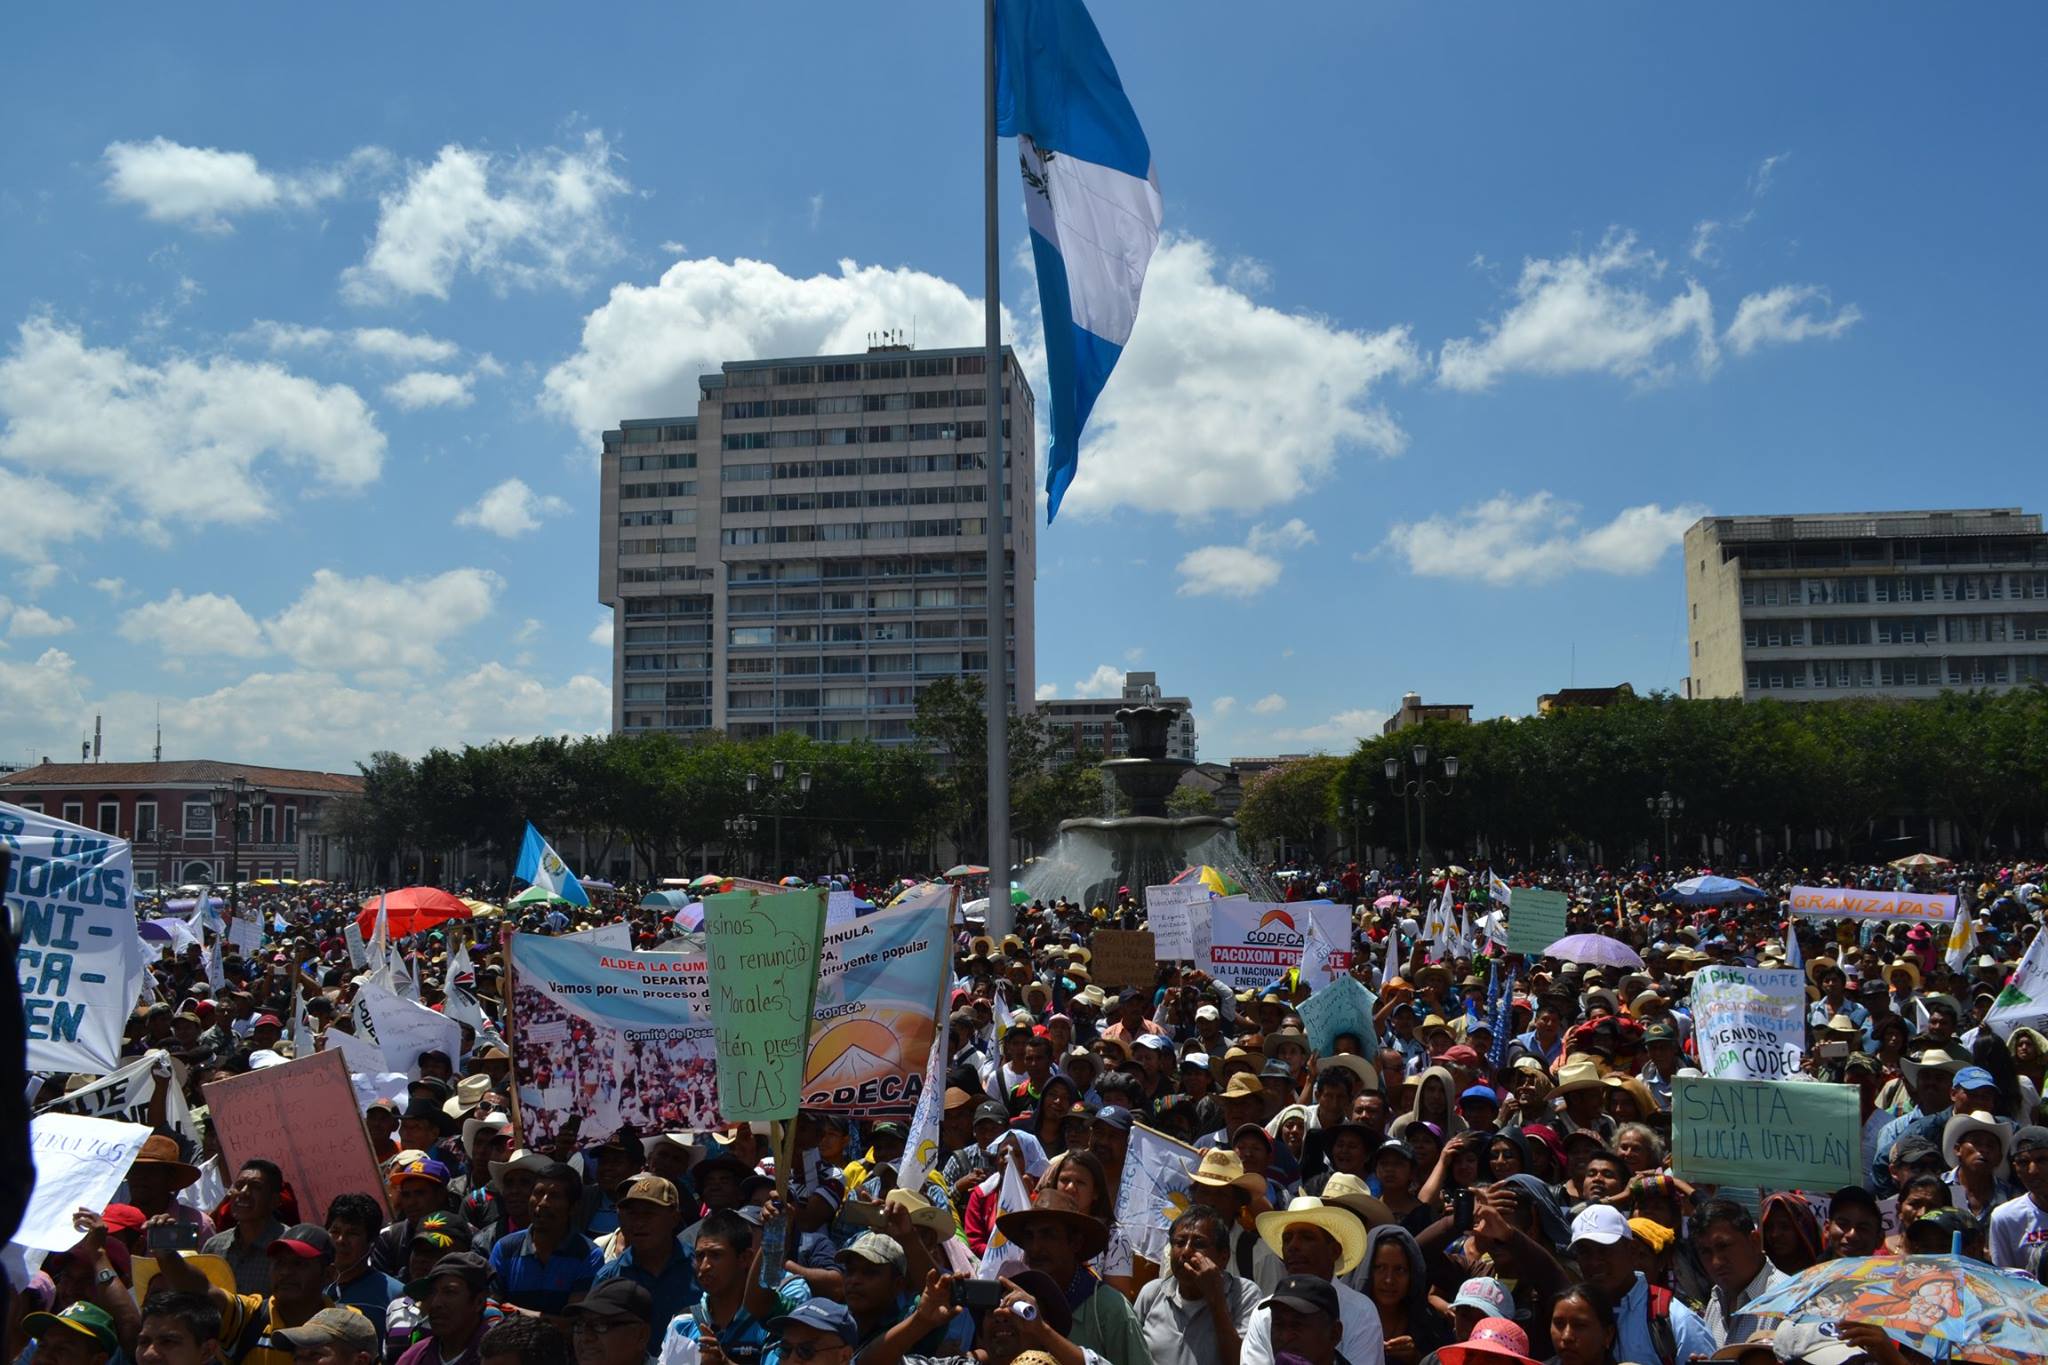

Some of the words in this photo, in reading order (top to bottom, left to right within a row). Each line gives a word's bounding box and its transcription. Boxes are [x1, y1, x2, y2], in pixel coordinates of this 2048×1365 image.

[1793, 895, 1945, 918] GRANIZADAS
[822, 925, 874, 947] PINULA,
[1247, 930, 1304, 944] CODECA
[712, 944, 726, 970] la
[740, 941, 806, 970] renuncia
[882, 940, 929, 961] popular
[1214, 948, 1275, 963] PACOXOM
[600, 957, 646, 971] ALDEA
[650, 963, 668, 972] LA
[672, 962, 709, 972] CUM
[1229, 967, 1239, 975] LA
[548, 981, 593, 995] Vamos
[597, 985, 618, 997] por
[623, 987, 638, 995] un
[644, 989, 697, 999] proceso
[701, 988, 710, 998] d
[642, 975, 709, 986] DEPARTA
[692, 1004, 700, 1012] y
[705, 1003, 712, 1012] p
[721, 984, 783, 1014] Morales
[624, 1028, 667, 1042] Comité
[669, 1028, 686, 1040] de
[687, 1027, 715, 1039] Desa
[1711, 1027, 1777, 1051] DIGNIDAD
[1743, 1047, 1804, 1076] CODEC
[800, 1072, 924, 1105] ODECA
[1683, 1084, 1793, 1125] SANTA
[1692, 1123, 1753, 1161] LUCÍA
[1761, 1130, 1851, 1169] UTATLÁN
